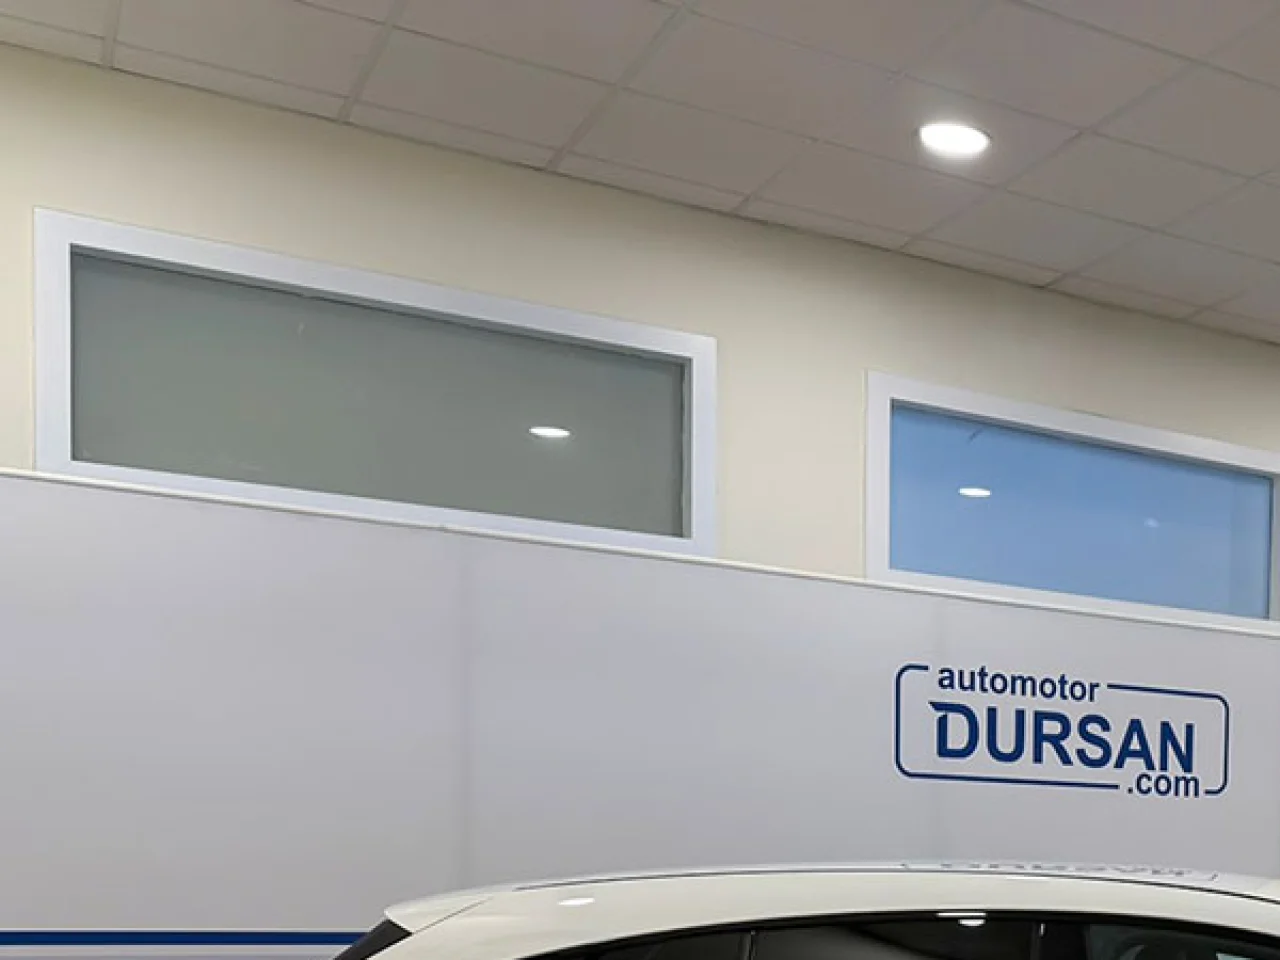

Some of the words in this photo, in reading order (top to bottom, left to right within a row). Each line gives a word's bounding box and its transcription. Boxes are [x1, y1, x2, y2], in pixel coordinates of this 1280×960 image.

[937, 665, 1100, 703] automotor
[928, 701, 1195, 775] DURSAN
[1127, 773, 1200, 799] .com
